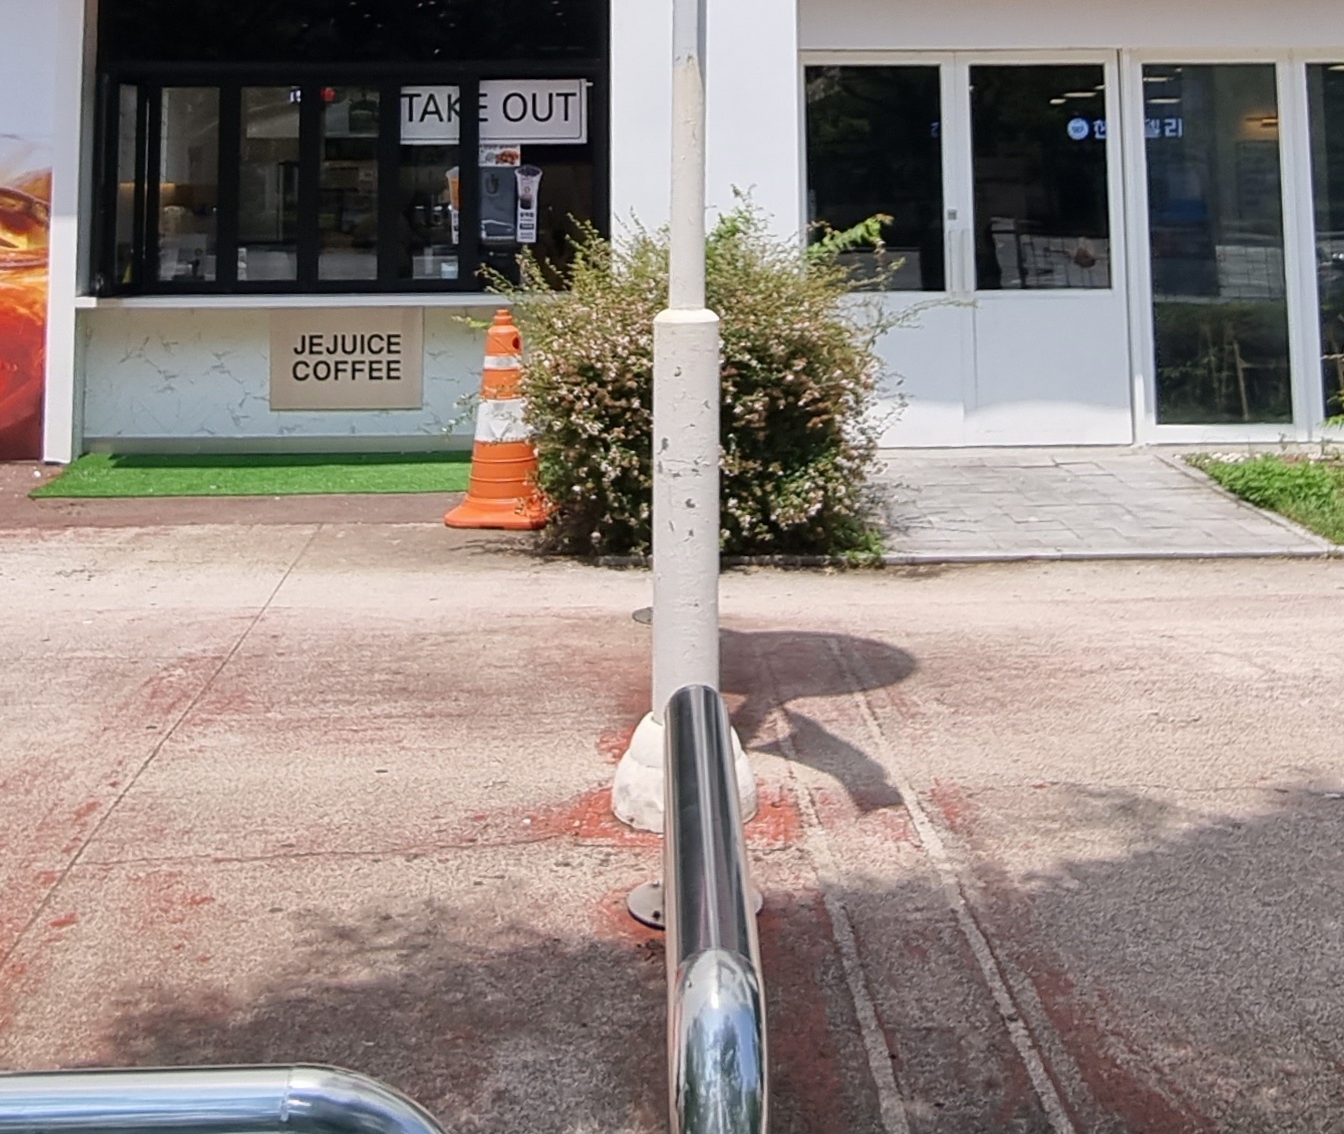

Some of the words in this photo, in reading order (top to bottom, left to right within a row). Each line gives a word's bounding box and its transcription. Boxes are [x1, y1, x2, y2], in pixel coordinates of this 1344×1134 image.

[502, 92, 577, 122] OUT
[292, 333, 402, 356] JEJUICE
[291, 359, 402, 382] COFFEE
